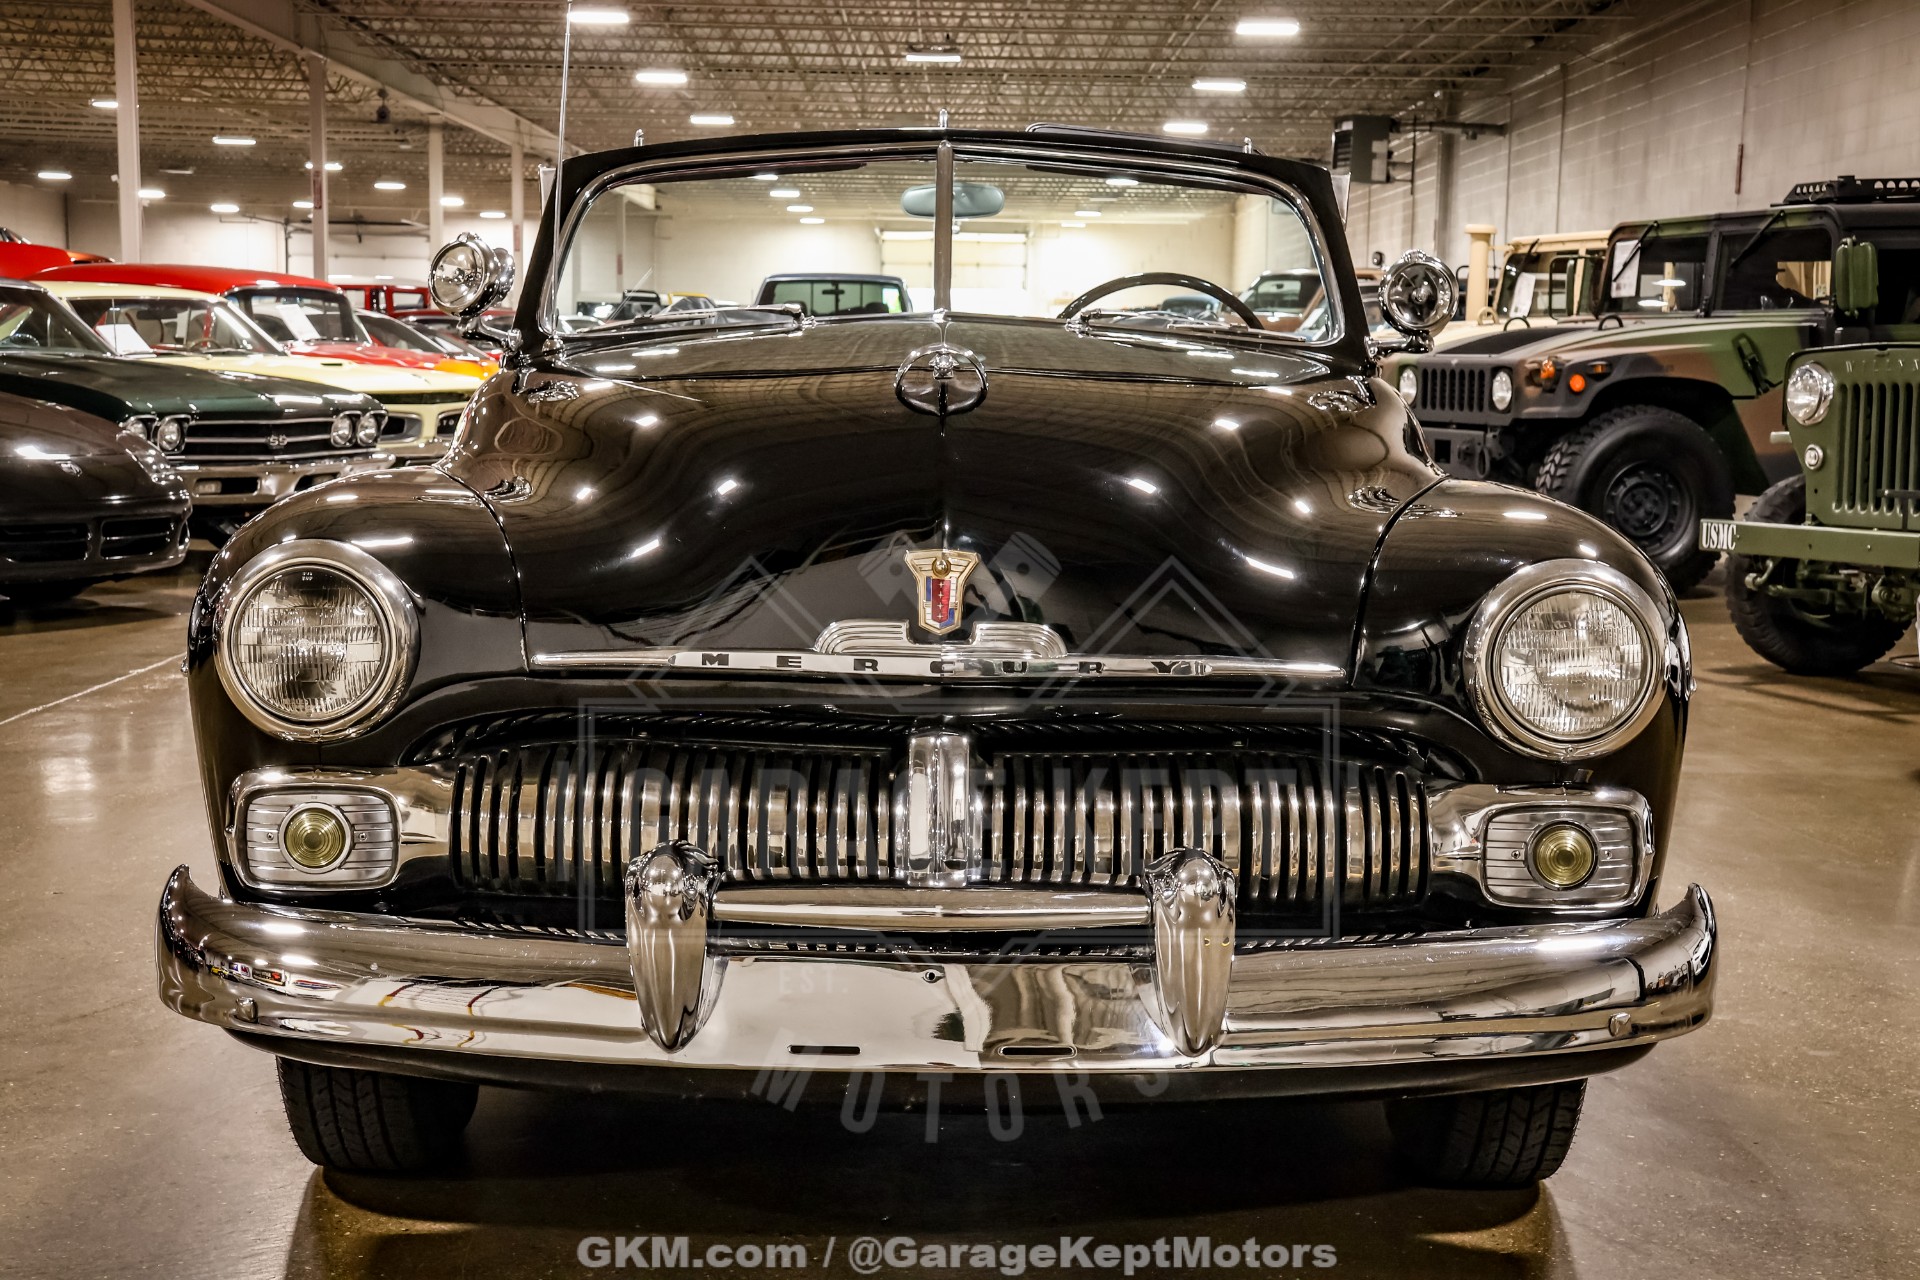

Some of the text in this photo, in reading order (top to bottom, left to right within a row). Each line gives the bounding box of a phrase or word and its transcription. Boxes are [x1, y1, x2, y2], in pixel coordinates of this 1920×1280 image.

[270, 435, 288, 446] SS
[1702, 522, 1737, 550] USMC
[701, 652, 1181, 675] MERCURY
